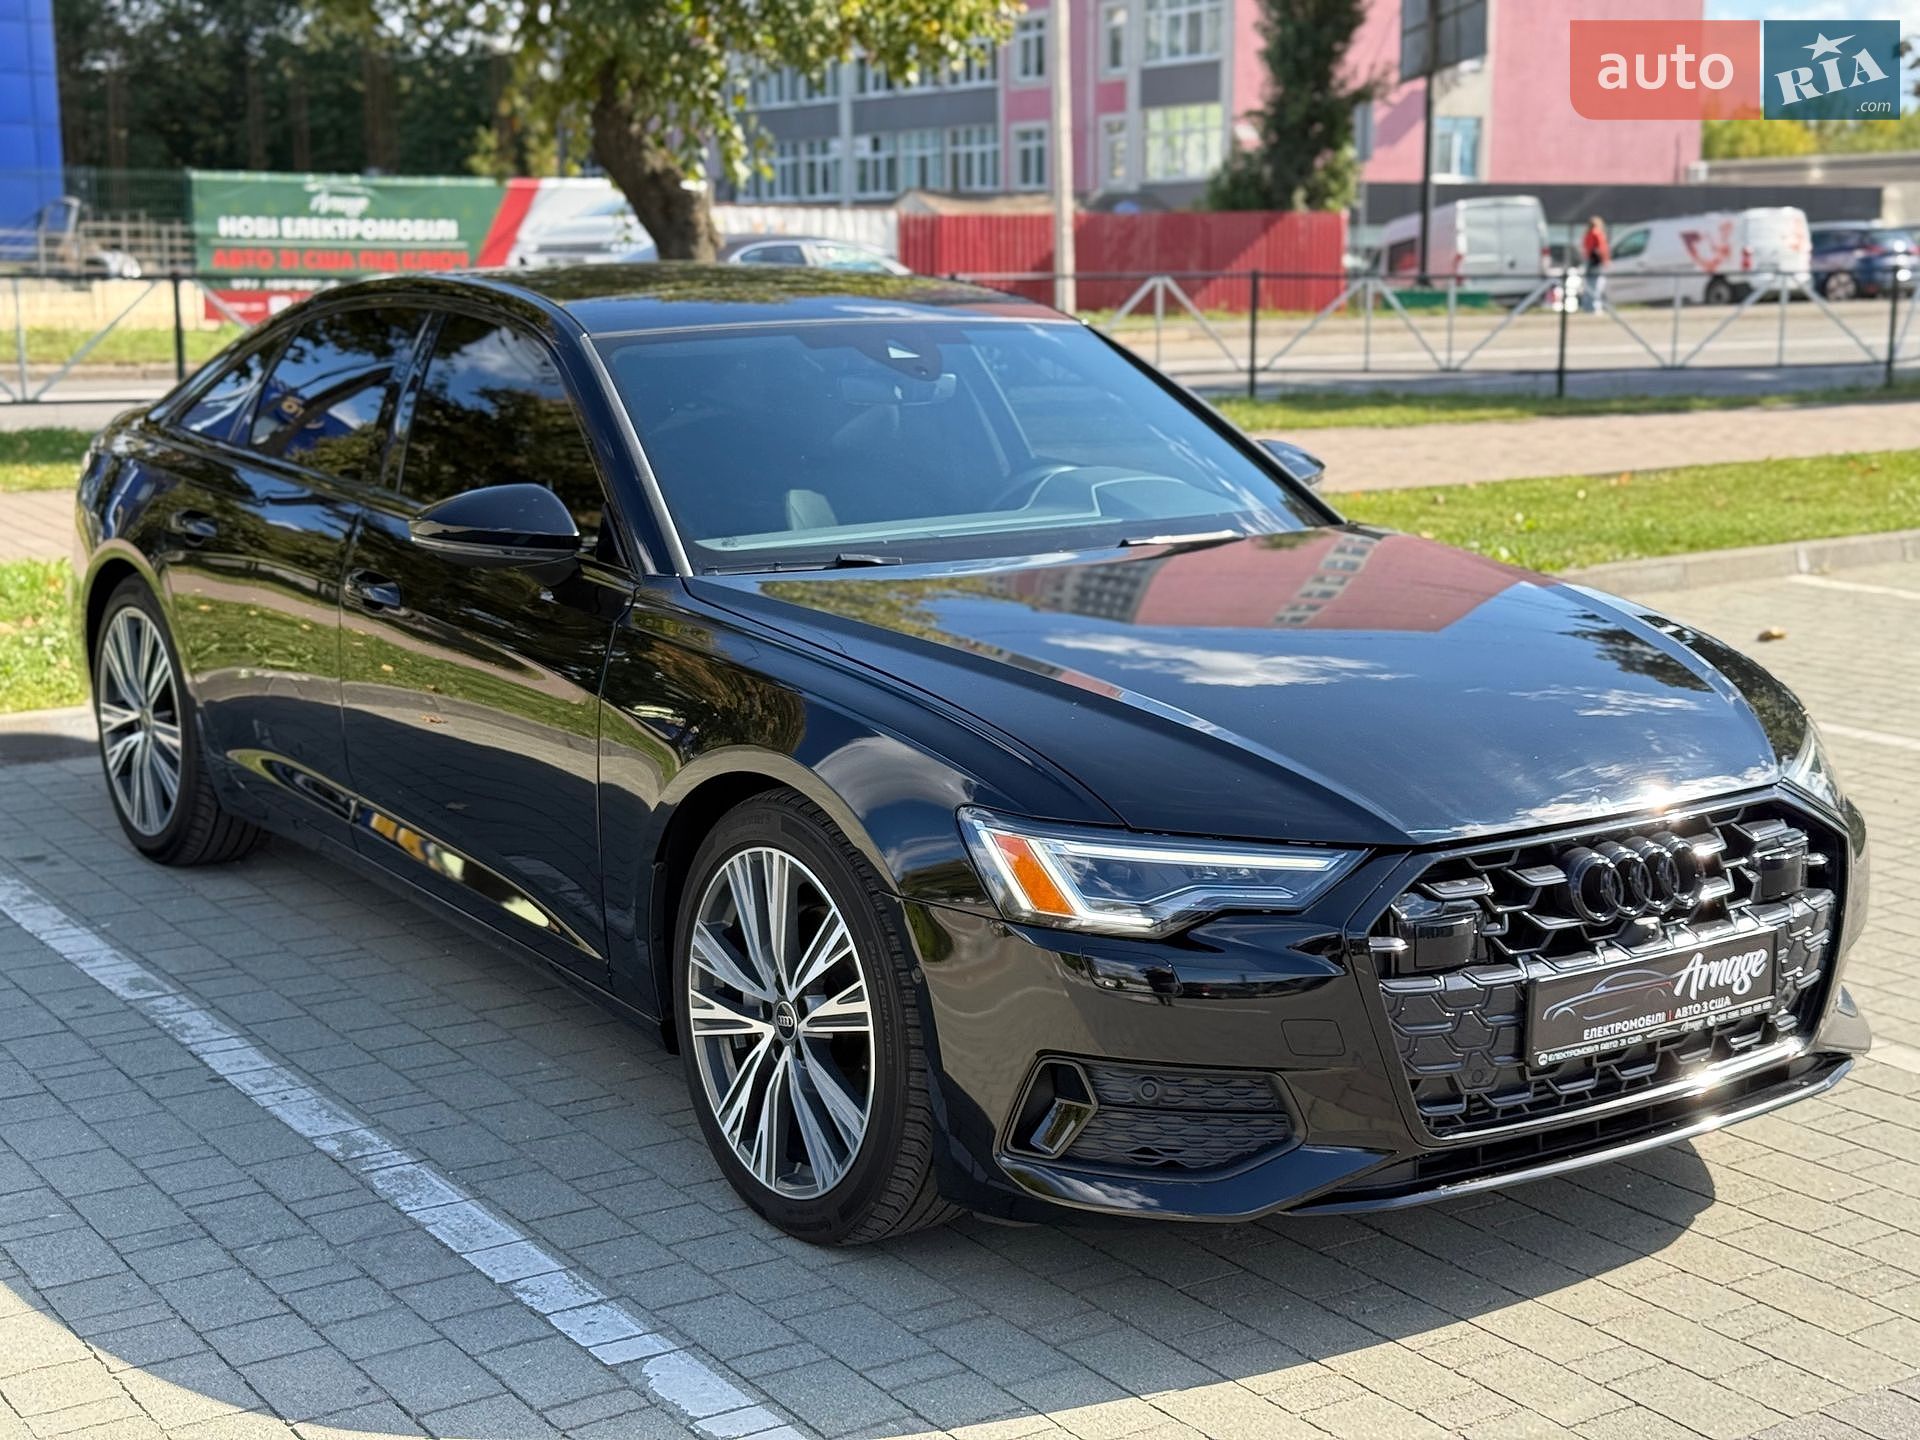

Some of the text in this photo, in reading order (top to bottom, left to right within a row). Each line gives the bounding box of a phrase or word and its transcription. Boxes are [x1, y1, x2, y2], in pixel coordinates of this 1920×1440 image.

[217, 216, 279, 238] НОВІ
[212, 248, 275, 269] АВТО
[302, 249, 354, 270] США
[1672, 948, 1769, 999] Arnage
[1583, 1013, 1666, 1040] ЕЛЕКТРОМОБІЛІ
[1674, 1003, 1702, 1019] АВТО
[1709, 996, 1731, 1011] США
